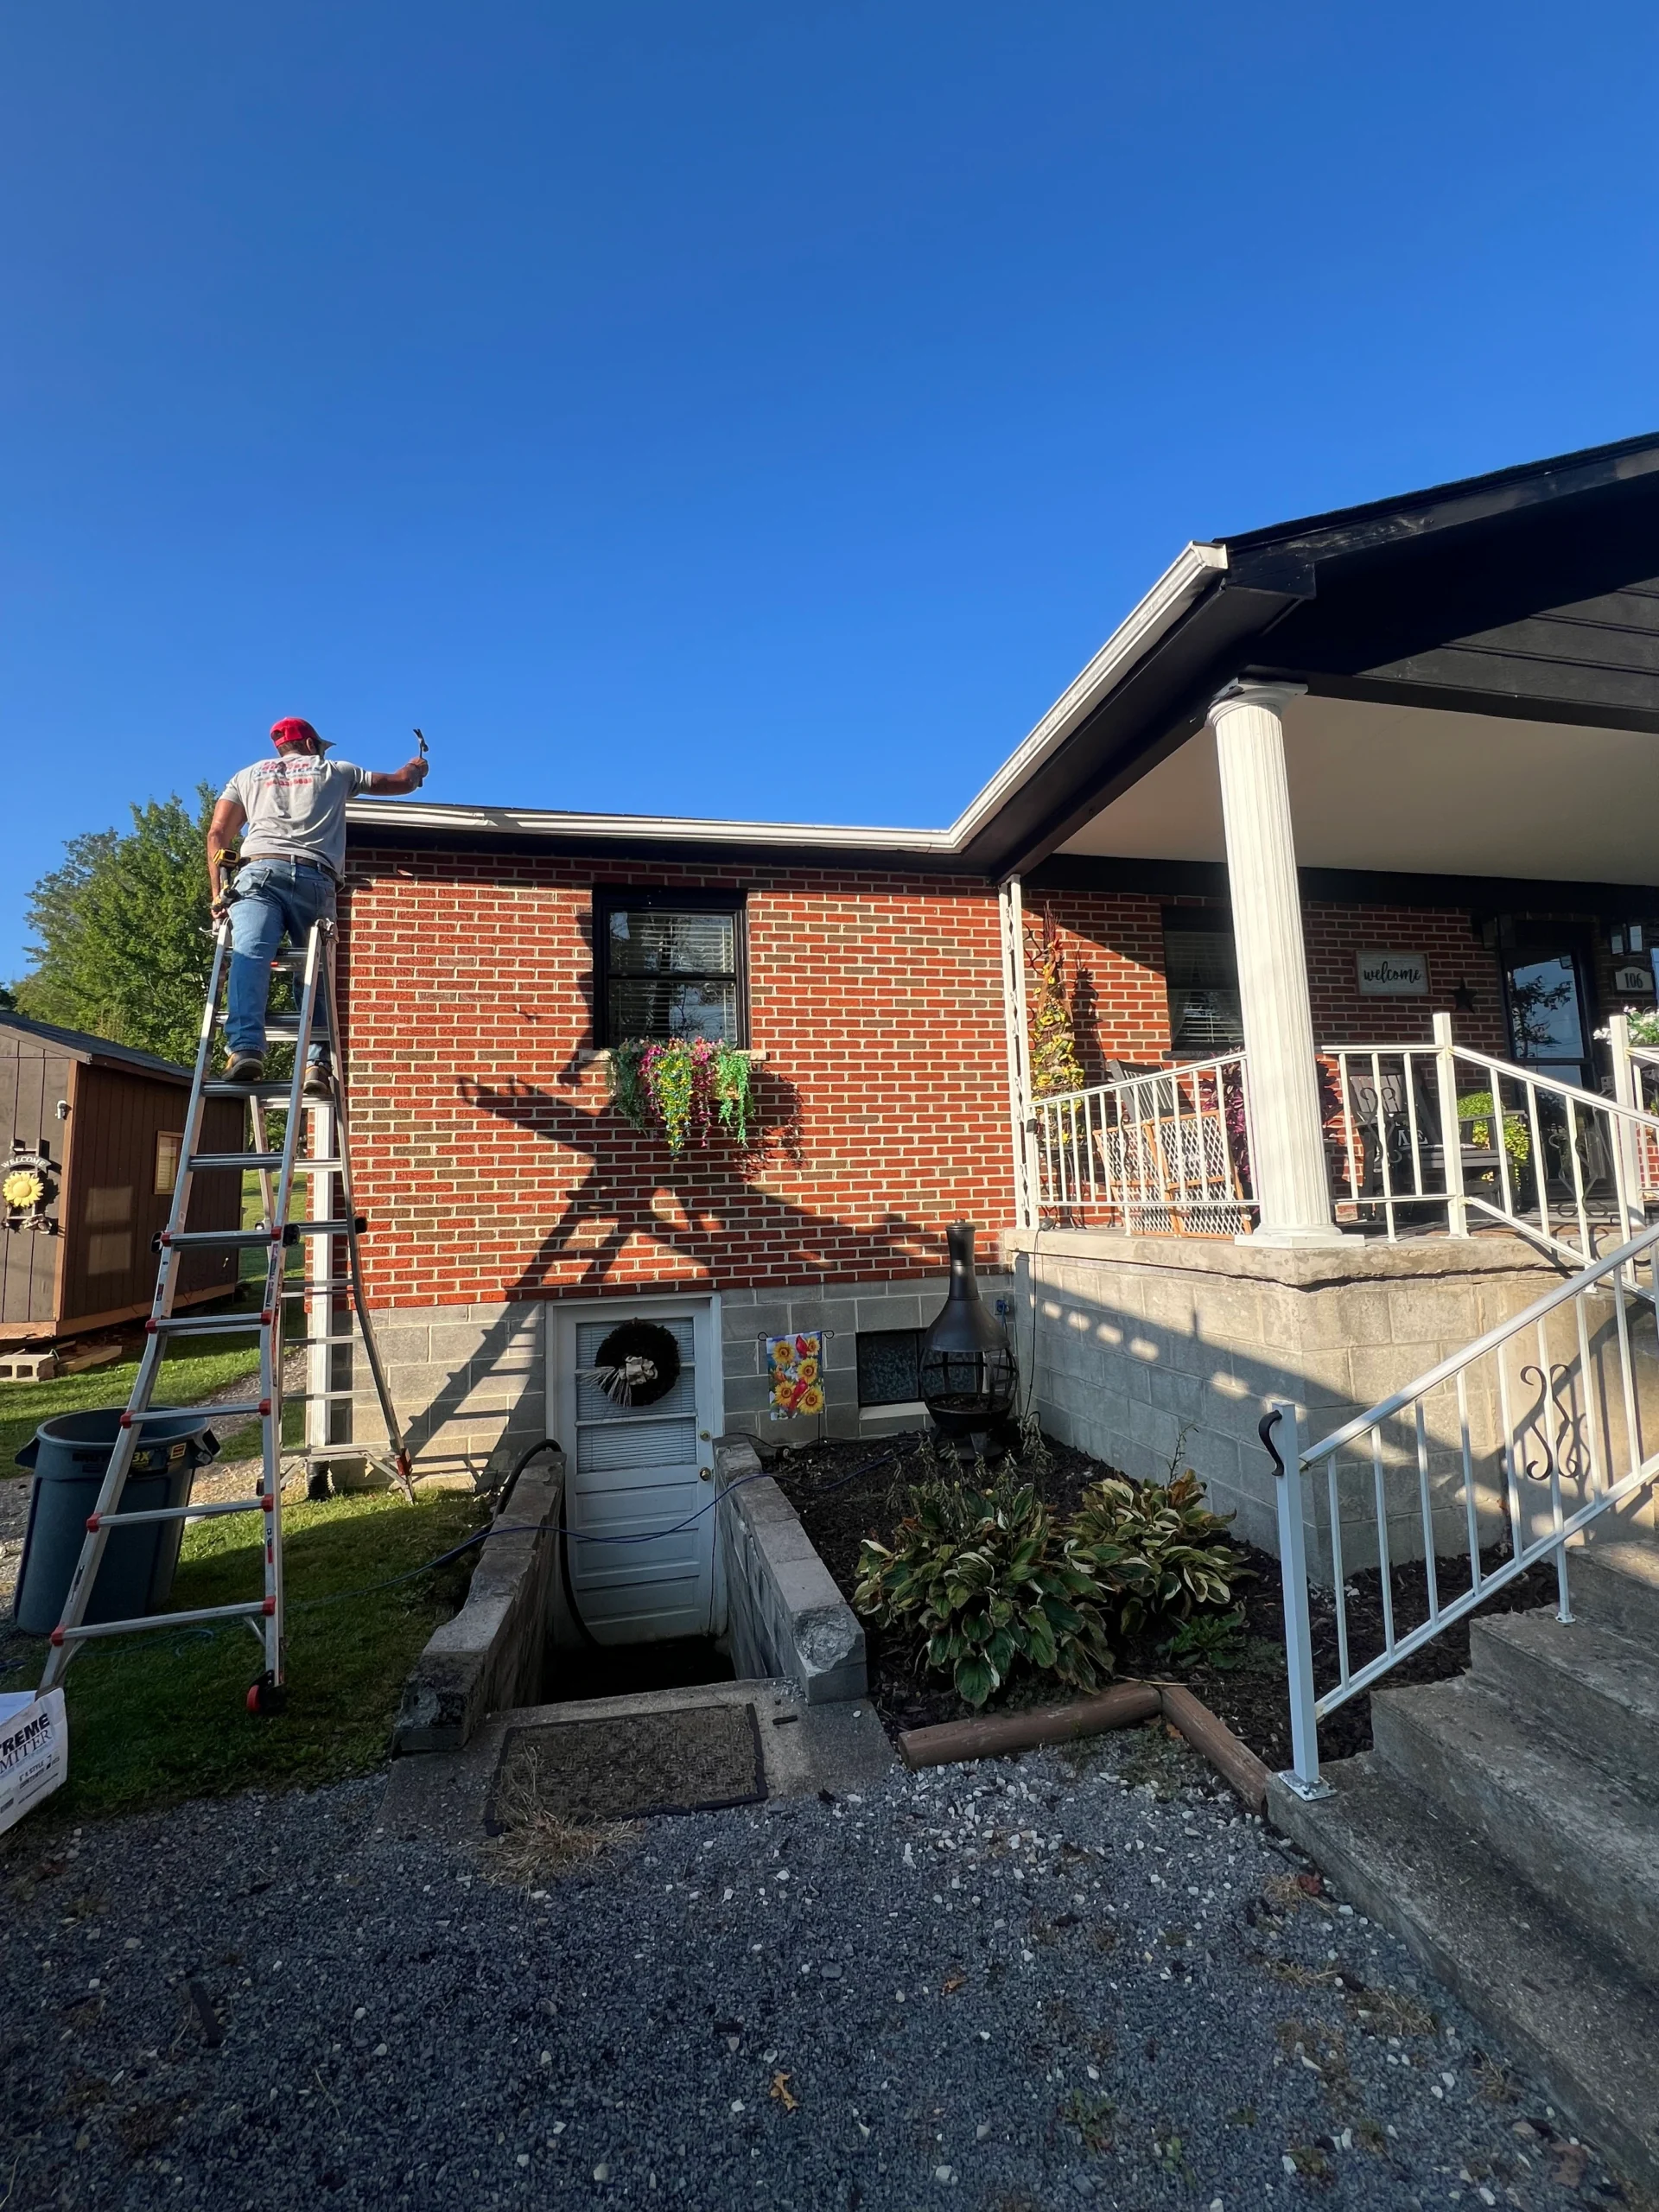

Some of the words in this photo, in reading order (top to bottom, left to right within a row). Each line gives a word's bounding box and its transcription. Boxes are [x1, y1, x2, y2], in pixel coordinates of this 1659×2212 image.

[1363, 961, 1421, 983] welcome
[1624, 973, 1643, 988] 106
[1, 1156, 46, 1167] WELCOME
[0, 1729, 52, 1774] MITER
